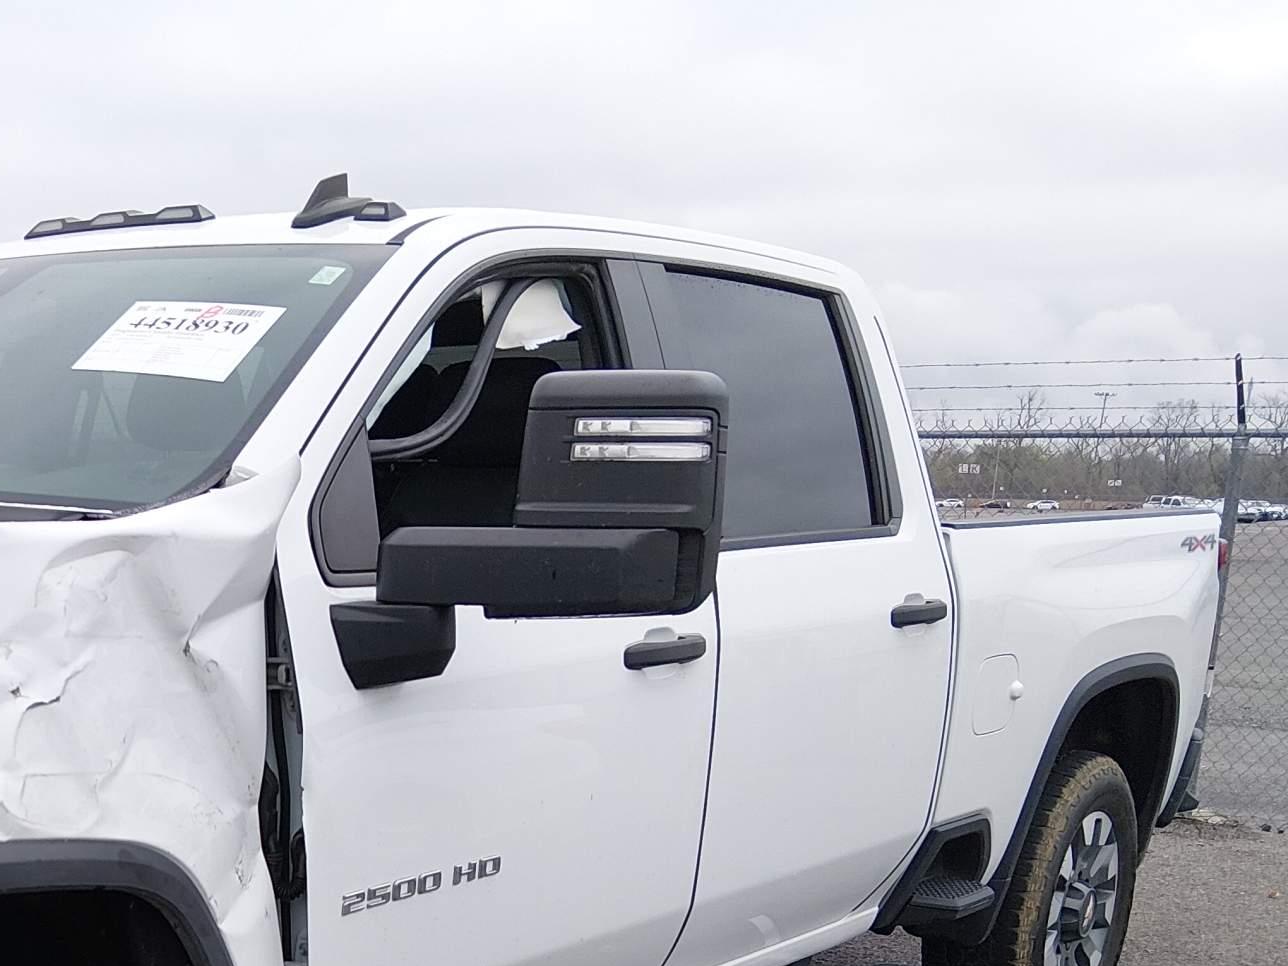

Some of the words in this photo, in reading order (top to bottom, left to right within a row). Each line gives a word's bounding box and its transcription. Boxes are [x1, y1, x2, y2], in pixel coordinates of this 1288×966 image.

[130, 316, 250, 336] 44518930
[341, 871, 443, 917] 2500
[452, 854, 503, 886] HD
